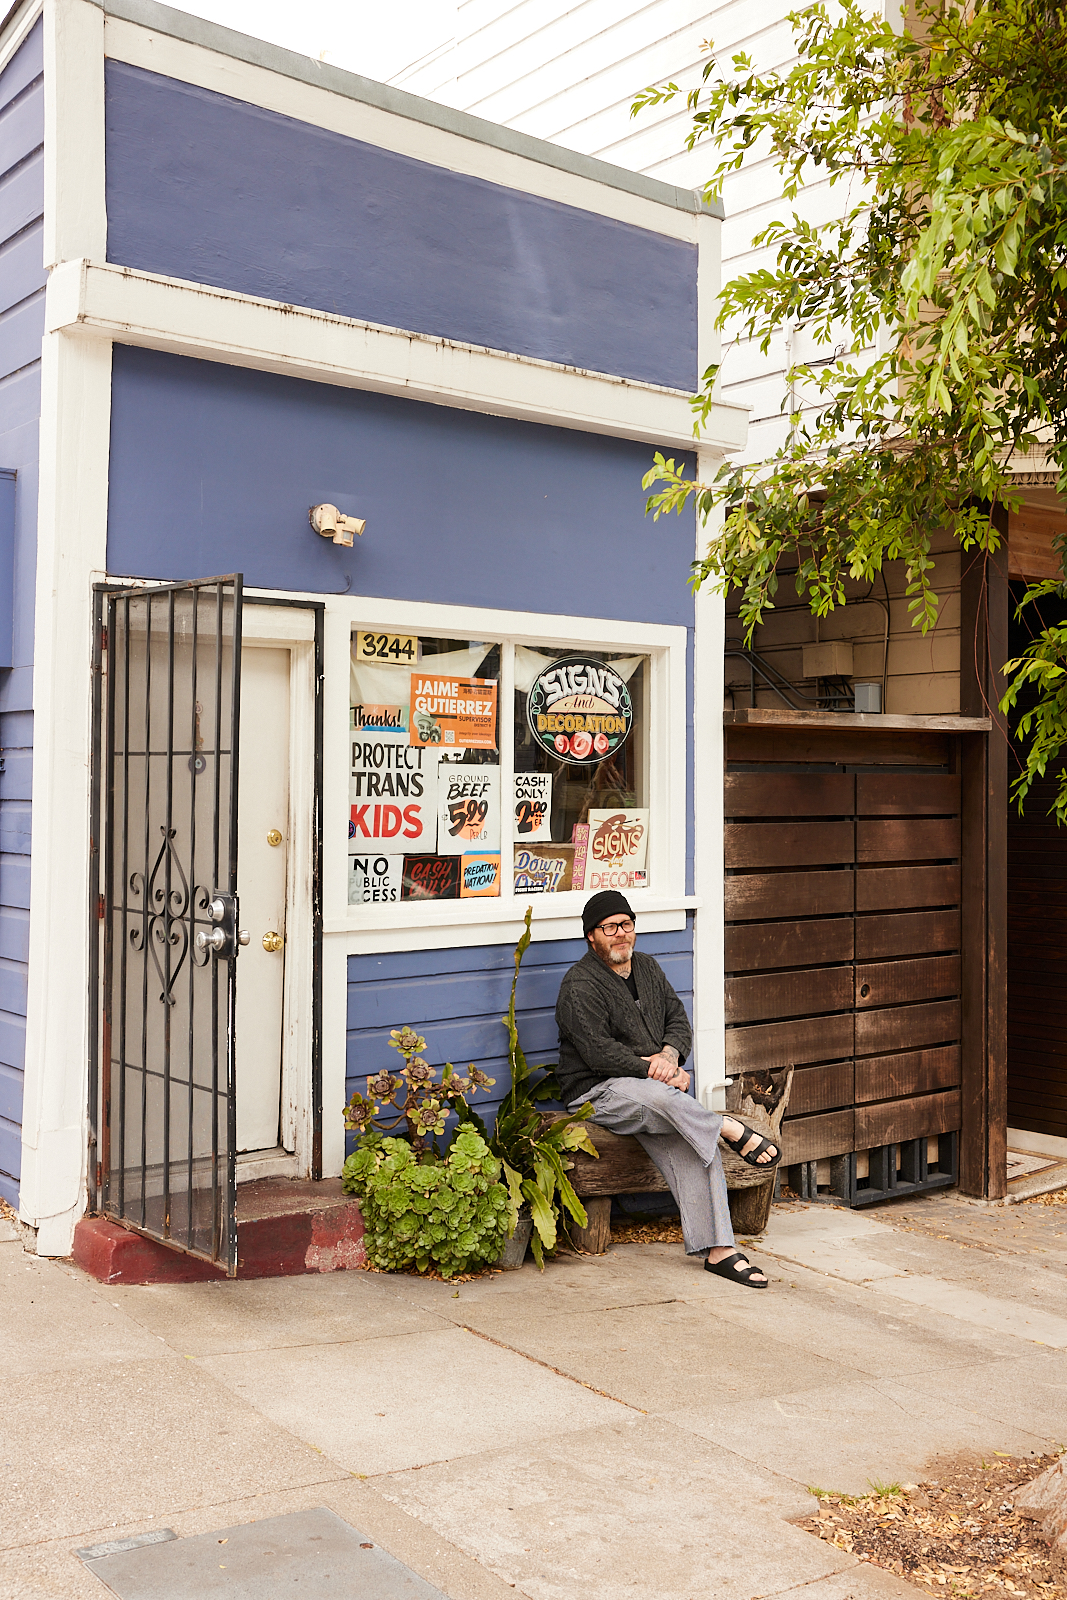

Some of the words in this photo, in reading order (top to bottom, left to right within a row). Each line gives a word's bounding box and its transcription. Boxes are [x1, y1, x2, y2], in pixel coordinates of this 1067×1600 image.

[363, 633, 415, 660] 3244
[415, 680, 459, 697] JAIME
[539, 665, 623, 708] SIGNS
[415, 697, 493, 716] GUTIERREZ
[564, 696, 595, 709] And
[350, 705, 402, 728] Thanks!
[537, 714, 627, 733] DECORATION
[352, 742, 426, 770] PROTECT
[352, 772, 424, 797] TRANS
[448, 775, 490, 783] GROUND
[515, 776, 546, 787] CASH
[447, 783, 491, 800] BEEF
[515, 788, 546, 799] ONLY
[350, 804, 424, 839] KIDS
[593, 831, 641, 860] SIGNS
[354, 857, 389, 876] NO
[411, 861, 453, 881] CASH
[463, 863, 500, 877] PREDATION
[514, 851, 564, 872] Down
[409, 879, 452, 897] ONLY
[463, 873, 497, 890] NATION!
